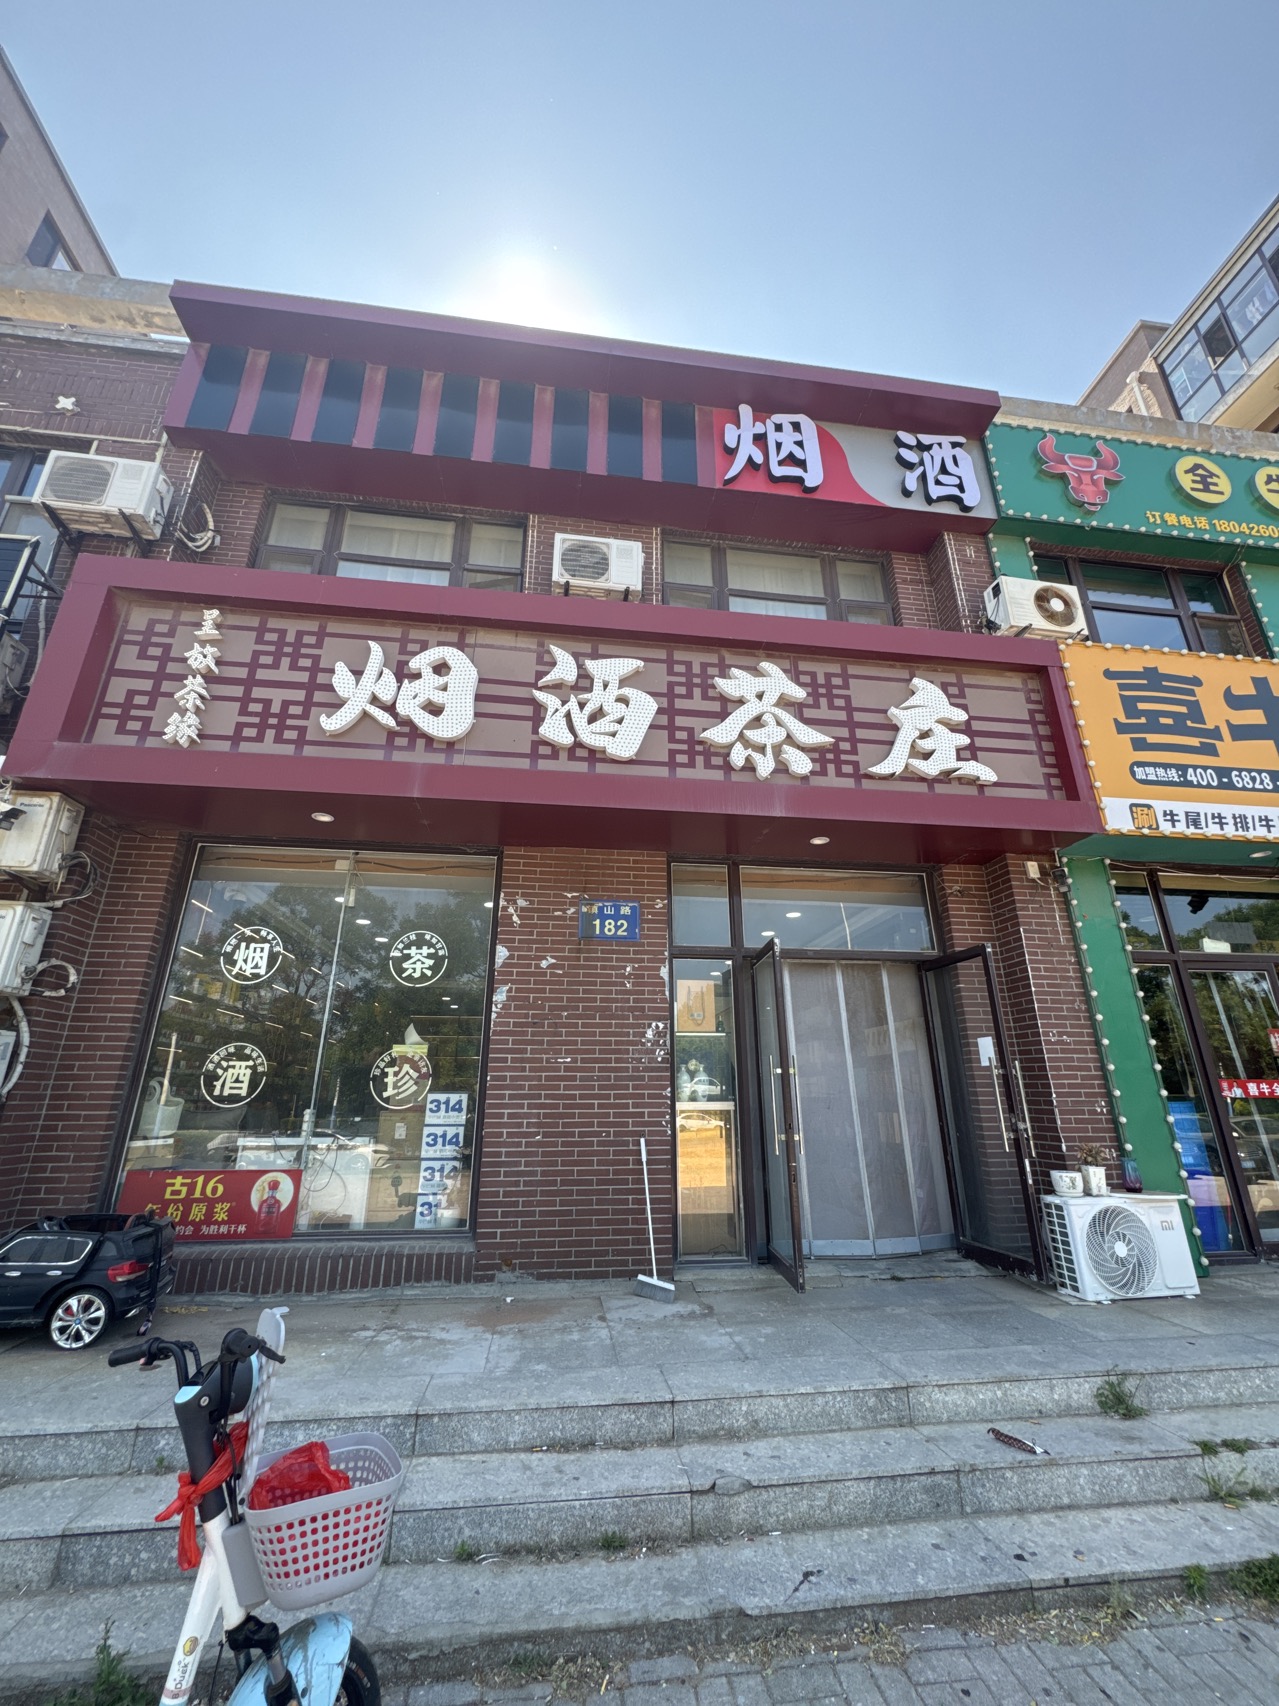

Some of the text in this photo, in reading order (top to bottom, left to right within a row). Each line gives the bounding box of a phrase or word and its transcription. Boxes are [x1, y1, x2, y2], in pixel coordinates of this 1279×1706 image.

[723, 403, 981, 513] 烟酒
[1146, 511, 1279, 538] 订餐电话 1804260
[319, 640, 998, 786] 烟酒茶庄
[1132, 806, 1157, 829] 涮
[592, 918, 628, 935] 182
[231, 942, 271, 976] 烟
[402, 946, 435, 978] 茶
[213, 1060, 255, 1096] 酒
[382, 1063, 420, 1099] 珍
[428, 1098, 464, 1114] 314
[425, 1132, 461, 1148] 314
[422, 1164, 458, 1182] 314
[164, 1174, 224, 1199] 古16
[144, 1202, 231, 1222] 年份原浆
[200, 1223, 248, 1235] 为胜利干杯
